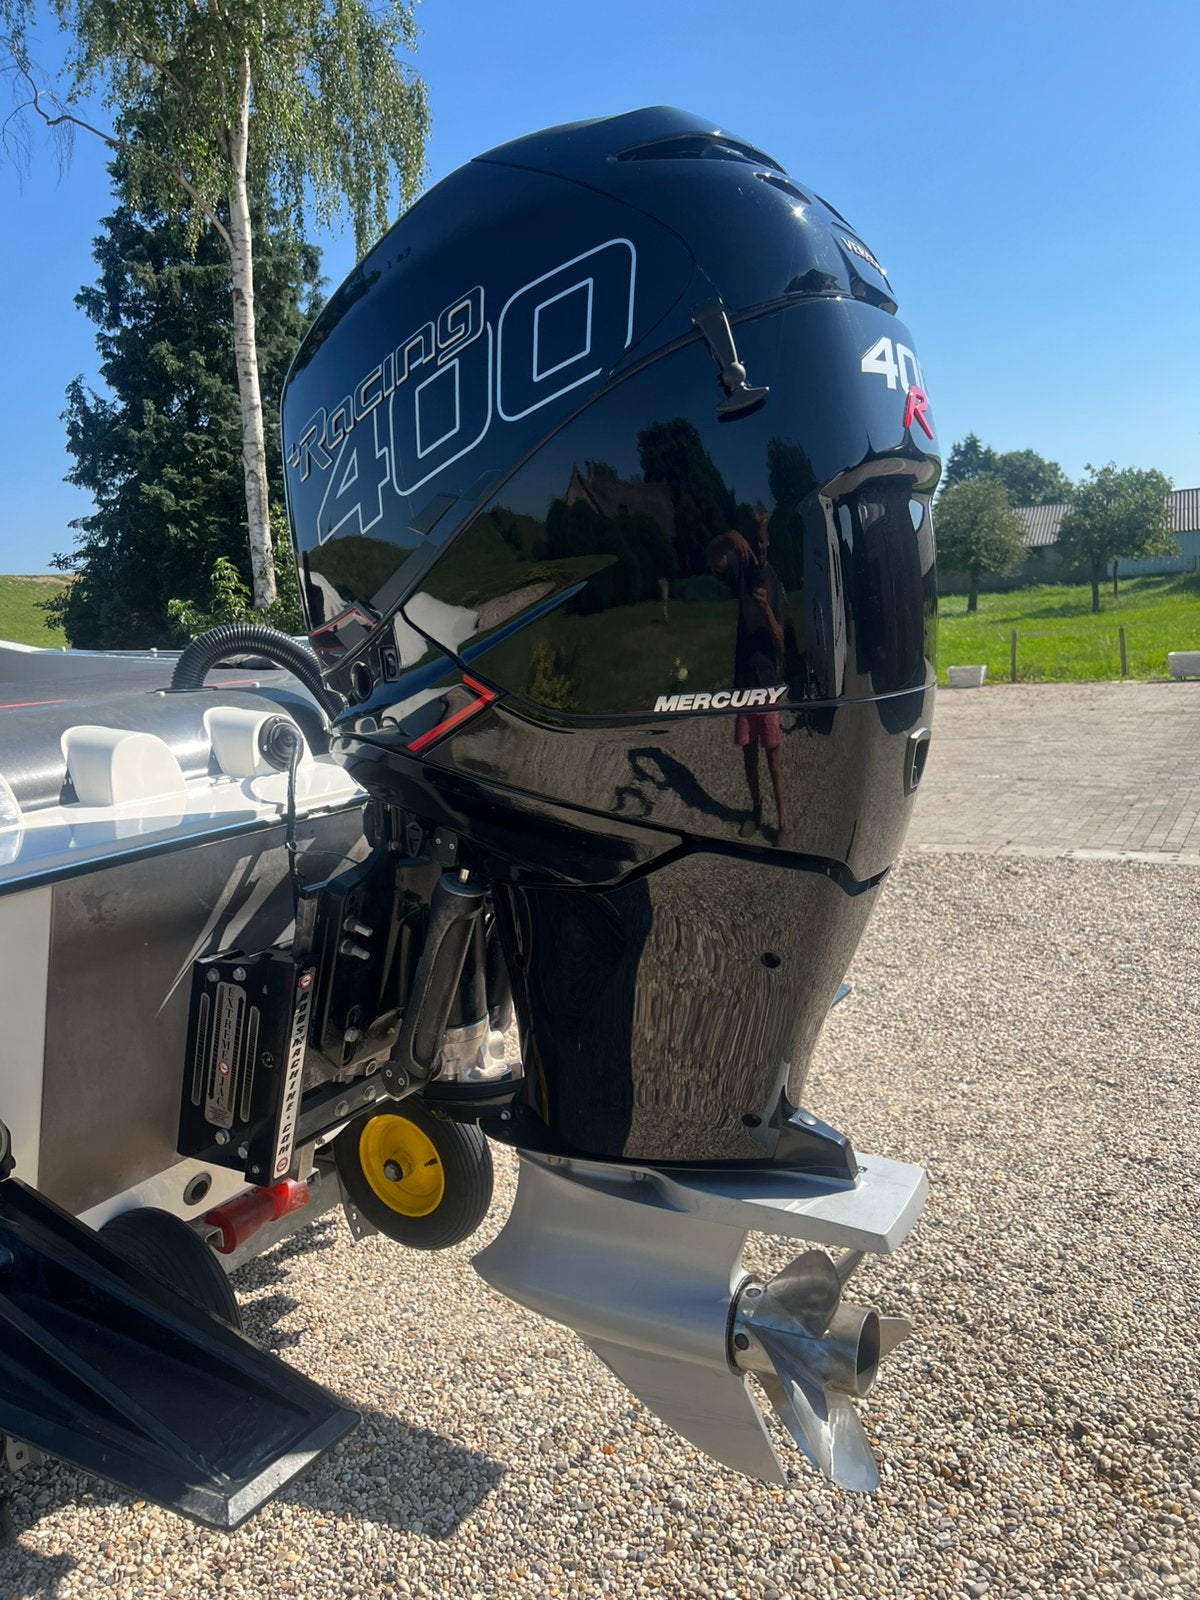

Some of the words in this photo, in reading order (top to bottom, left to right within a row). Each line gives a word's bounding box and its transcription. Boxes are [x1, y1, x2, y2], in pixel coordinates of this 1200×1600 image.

[317, 238, 637, 546] 400
[861, 336, 928, 398] 40
[653, 686, 788, 713] MERCURY
[221, 987, 235, 1061] EXTREME
